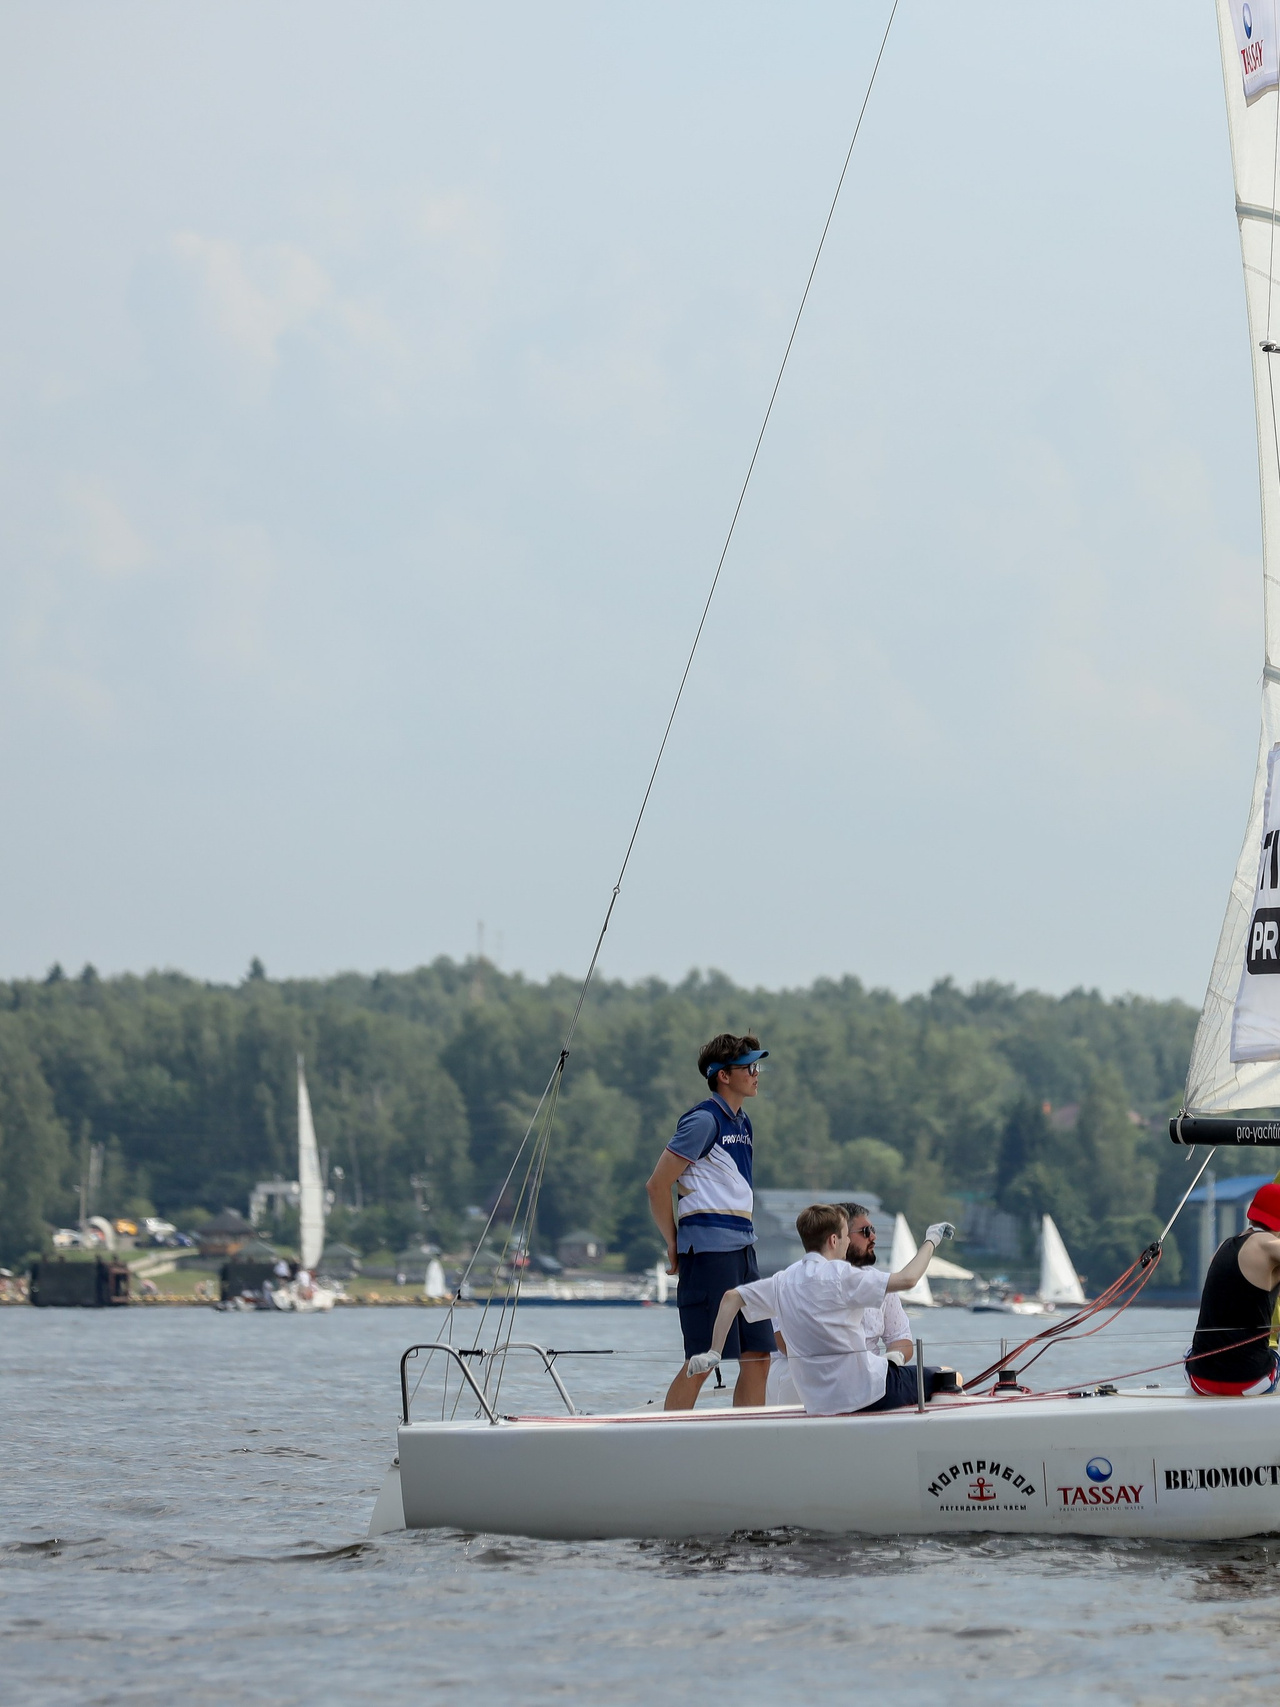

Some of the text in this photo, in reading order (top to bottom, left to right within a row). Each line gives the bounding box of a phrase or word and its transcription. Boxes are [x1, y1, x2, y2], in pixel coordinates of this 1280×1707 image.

[927, 1460, 1036, 1498] МОРПРИБОР
[1056, 1485, 1144, 1506] TASSAY
[939, 1504, 1001, 1512] ЛЕГЕНДАРНЫЕ
